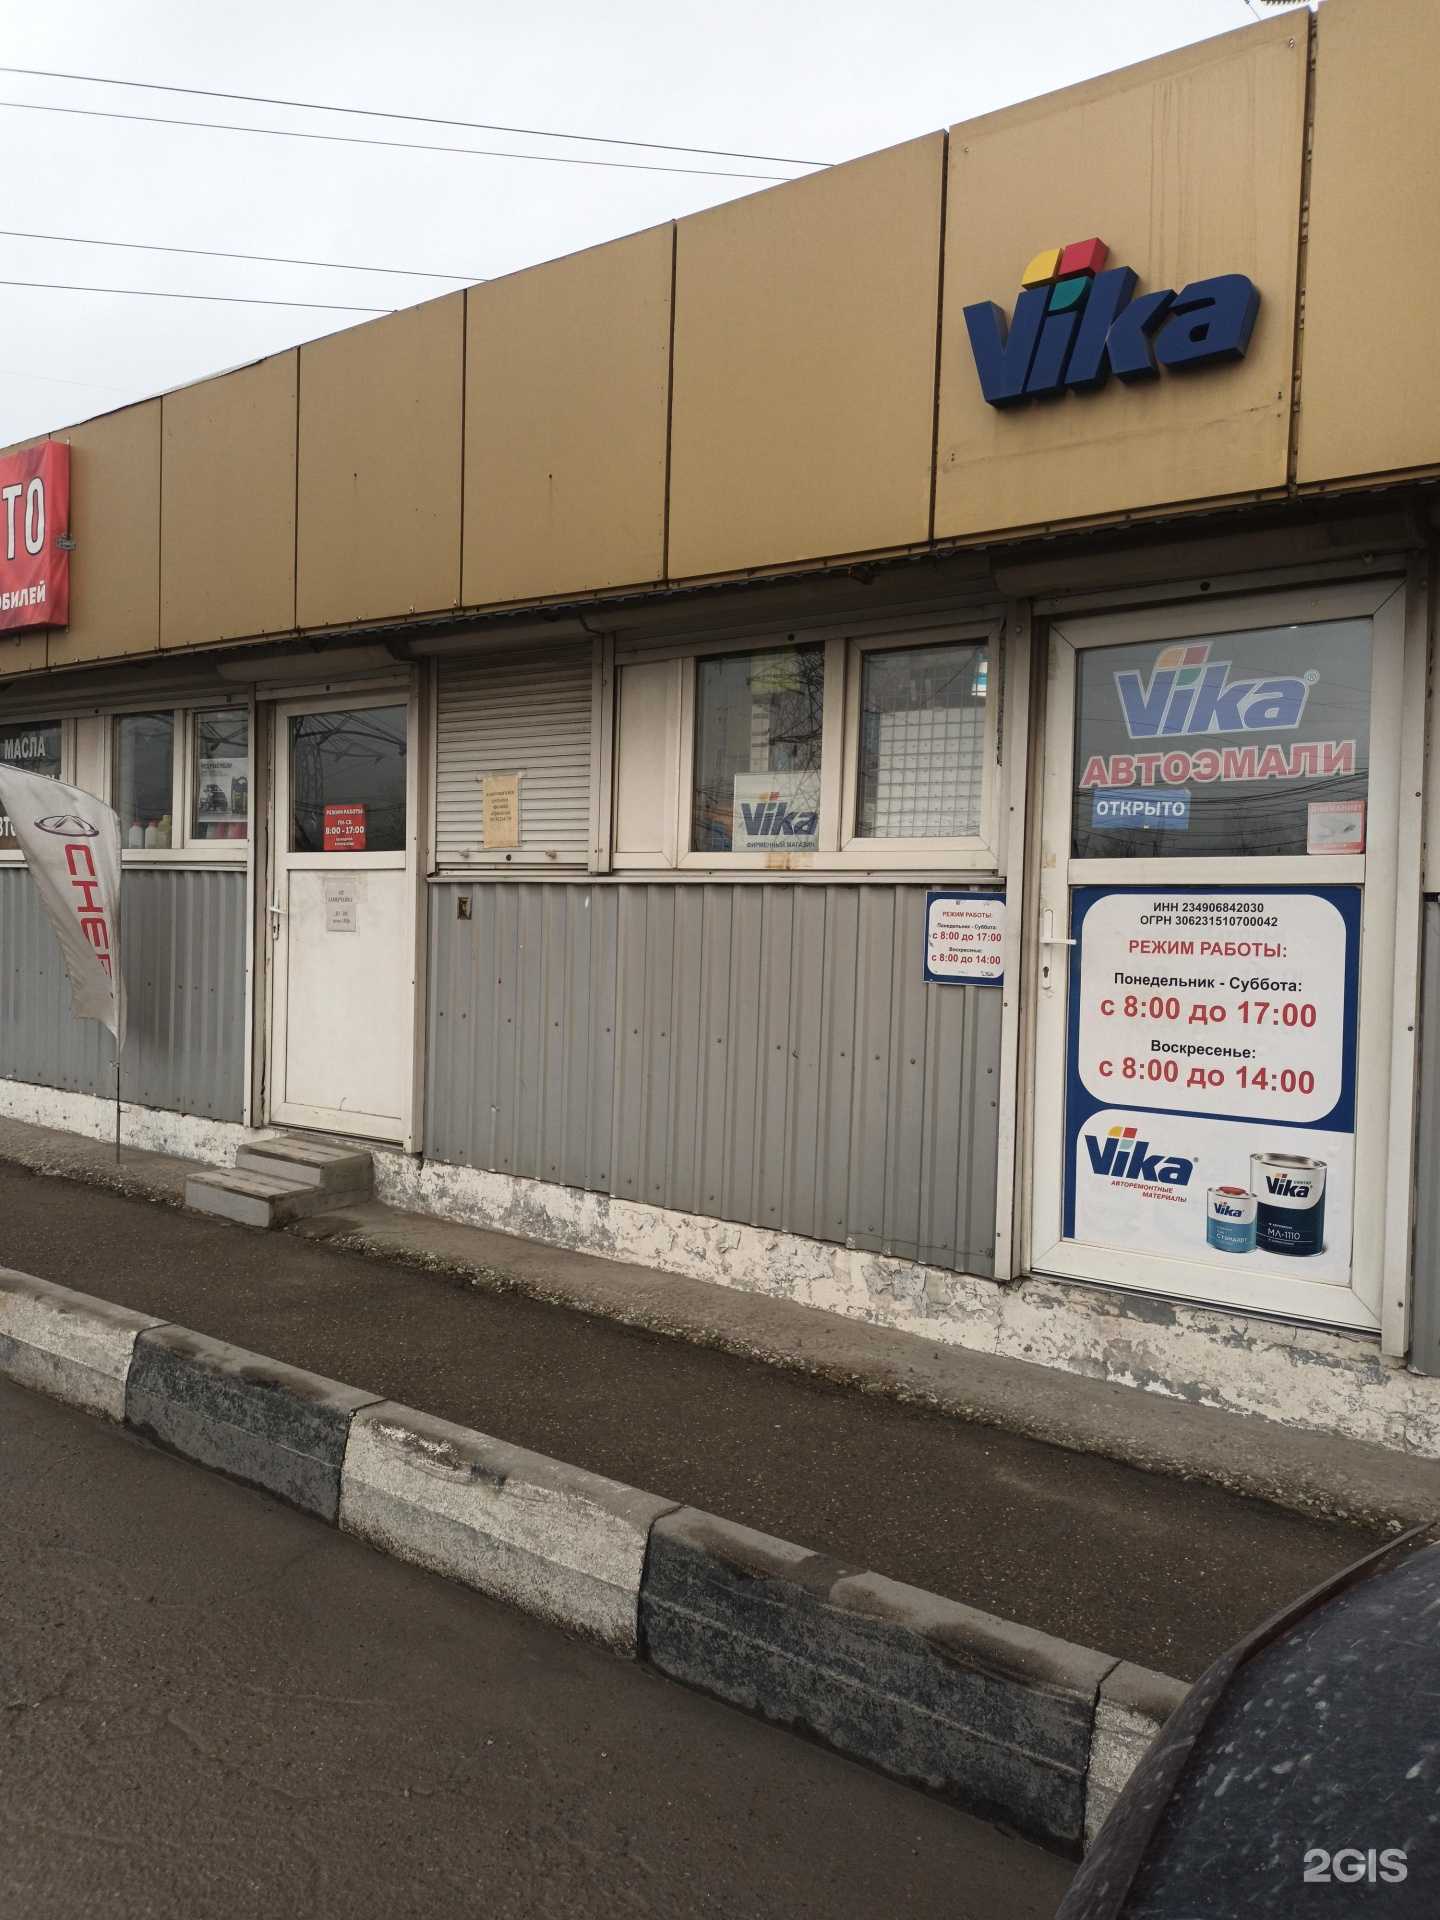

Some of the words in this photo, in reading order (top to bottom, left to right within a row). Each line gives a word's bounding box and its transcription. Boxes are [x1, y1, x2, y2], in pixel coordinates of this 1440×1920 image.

[963, 237, 1261, 408] Vika
[4, 736, 46, 759] МАСЛА
[1078, 739, 1357, 789] АВТОЭМАЛИ
[740, 791, 819, 836] Vika
[1096, 800, 1186, 818] ОТКРЫТО
[1153, 902, 1179, 913] ИНН
[1182, 902, 1264, 913] 234906842030
[1140, 915, 1172, 926] ОГРН
[1175, 915, 1278, 927] 306231510700042
[940, 931, 960, 940] 8:00
[961, 934, 974, 942] до
[976, 933, 1002, 942] 17:00
[1128, 939, 1194, 955] РЕЖИМ
[1200, 941, 1288, 958] РАБОТЫ:
[939, 953, 959, 963] 8:00
[960, 957, 973, 965] до
[975, 955, 1001, 965] 14:00
[1114, 972, 1215, 989] Понедельник
[1229, 976, 1303, 993] Суббота:
[1100, 1000, 1115, 1016] с
[1123, 994, 1181, 1020] 8:00
[1188, 1005, 1227, 1026] до
[1238, 1000, 1317, 1028] 17:00
[1150, 1039, 1256, 1059] Воскресенье:
[1099, 1061, 1113, 1077] с
[1122, 1056, 1179, 1083] 8:00
[1186, 1068, 1225, 1089] до
[1236, 1066, 1316, 1095] 14:00
[1085, 1126, 1195, 1187] Vika
[1111, 1179, 1174, 1194] АВТОРЕМОНТНЫЕ
[1265, 1173, 1311, 1198] Vika
[1142, 1191, 1188, 1203] МАТЕРИАЛЫ
[1214, 1201, 1243, 1218] Vika
